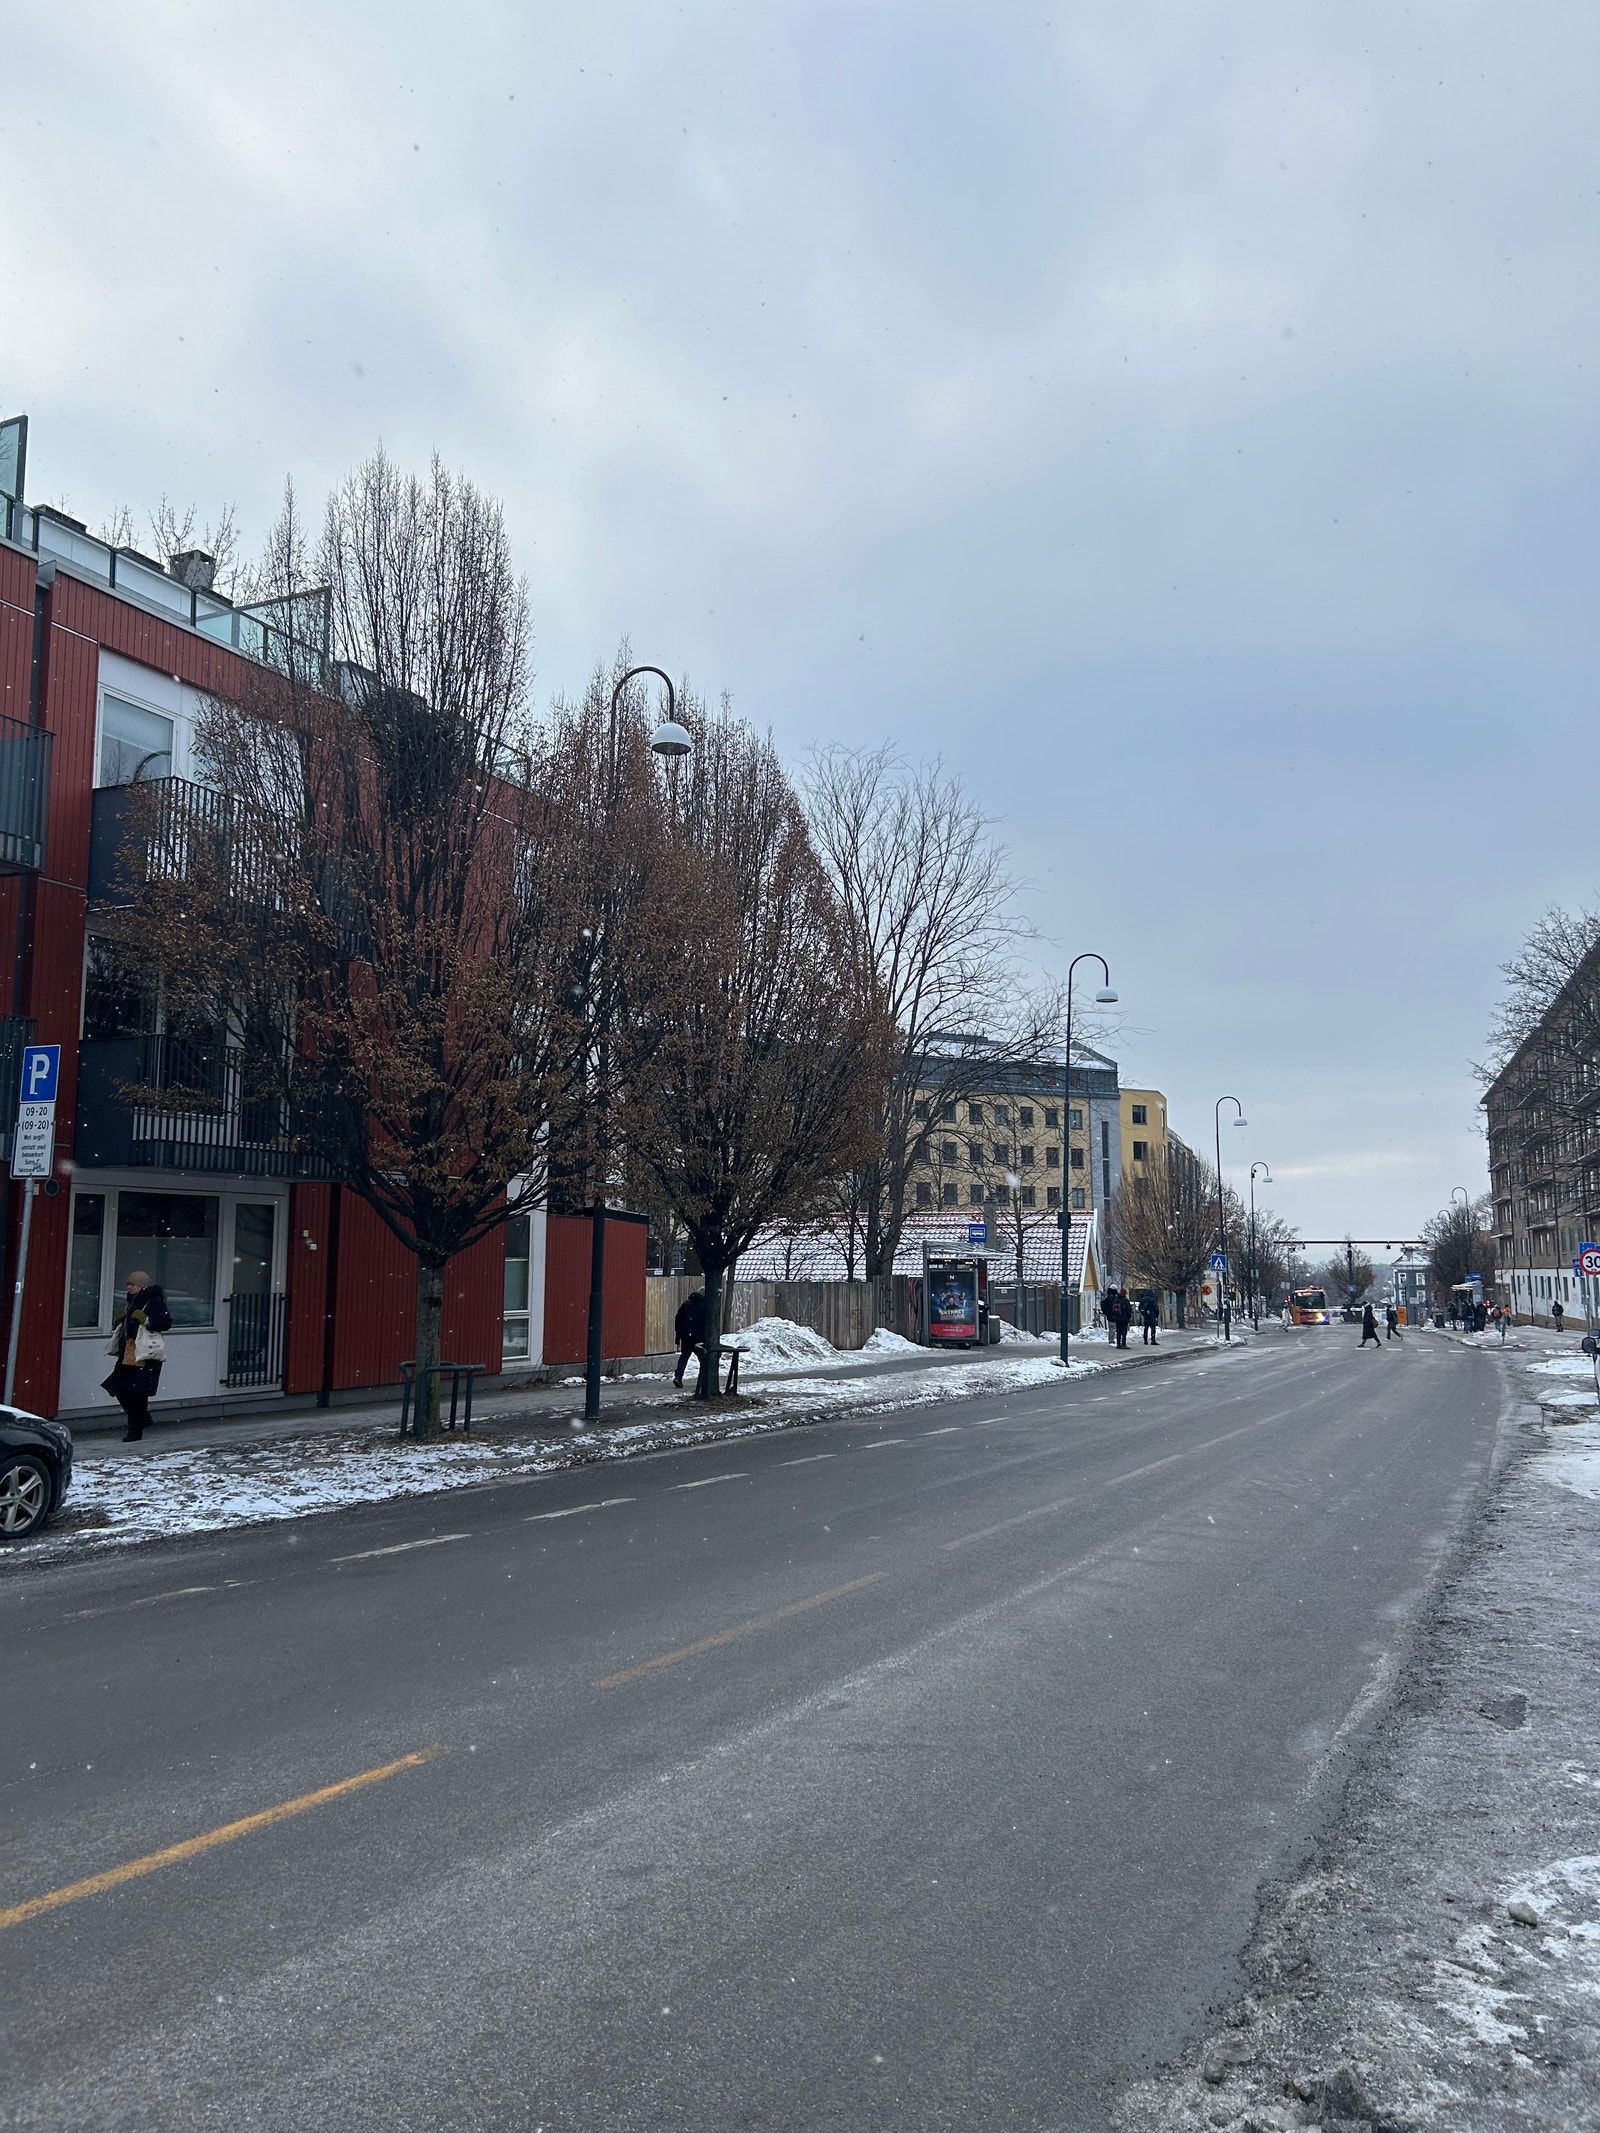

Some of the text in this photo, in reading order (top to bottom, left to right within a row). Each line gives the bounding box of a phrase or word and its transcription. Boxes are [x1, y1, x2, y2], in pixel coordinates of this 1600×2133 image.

[30, 1054, 50, 1094] P
[26, 1106, 48, 1116] 09-20
[22, 1120, 49, 1130] (09-20)
[1585, 1256, 1600, 1268] 30
